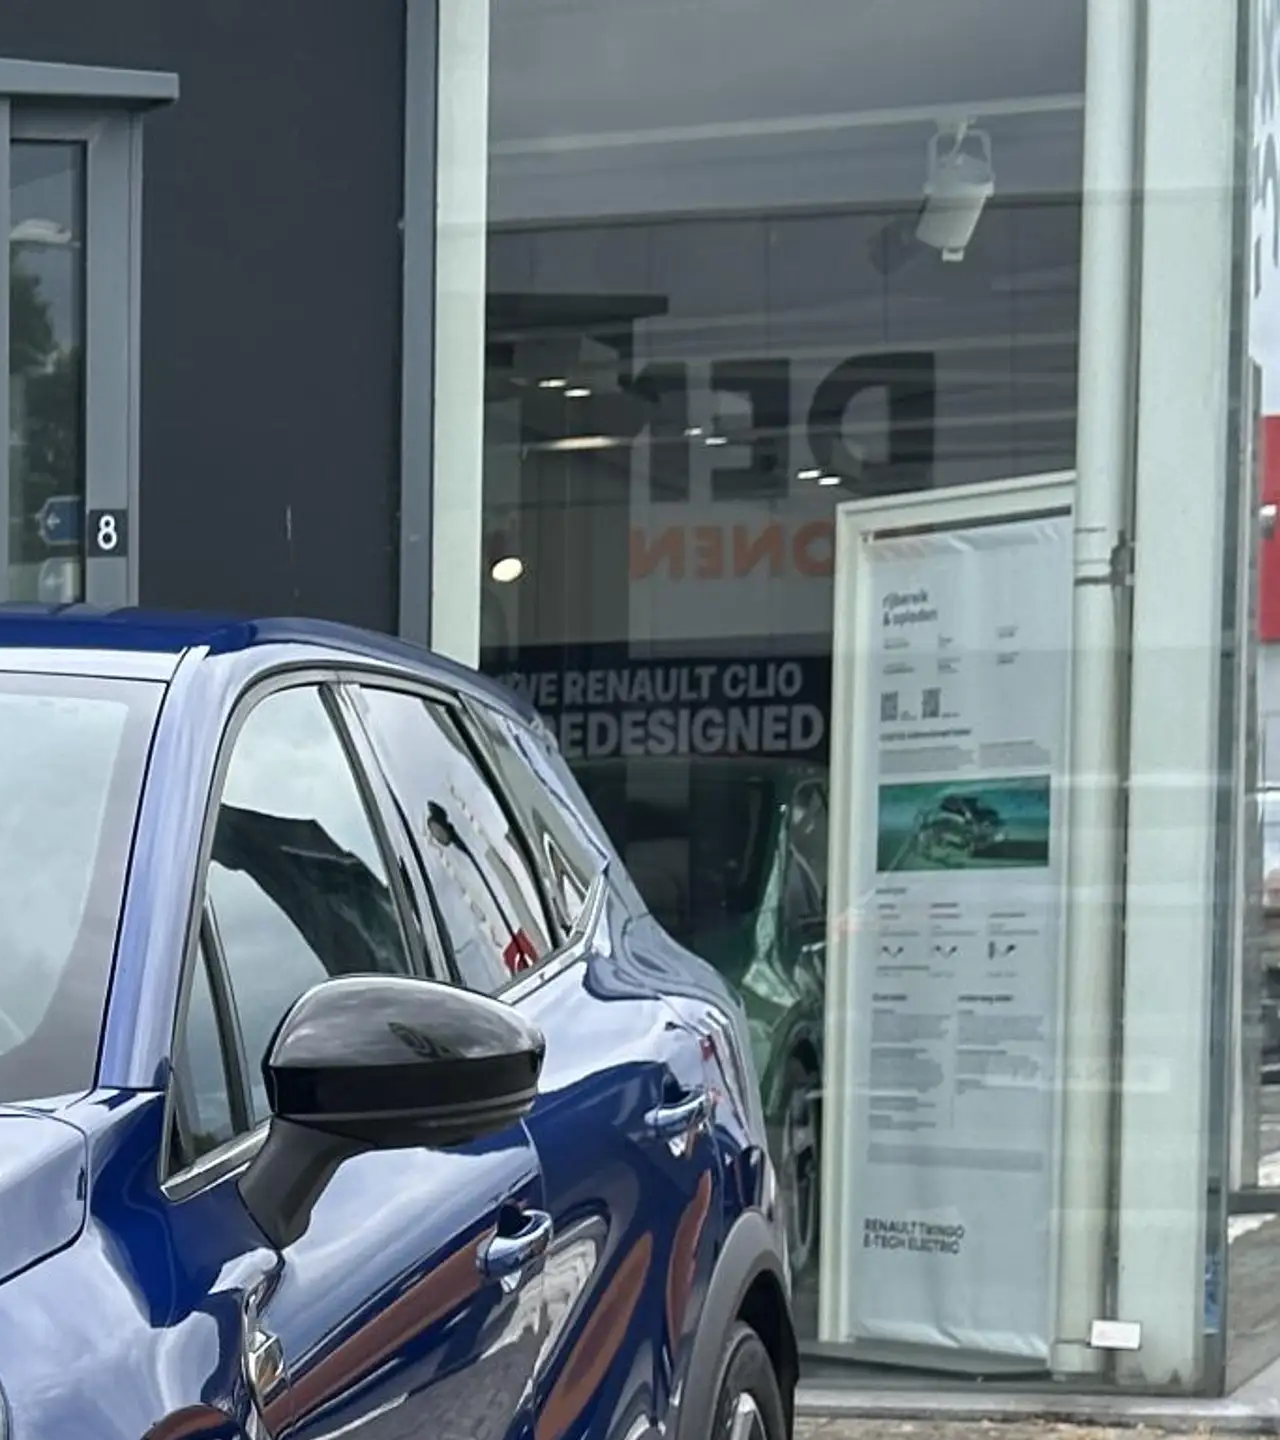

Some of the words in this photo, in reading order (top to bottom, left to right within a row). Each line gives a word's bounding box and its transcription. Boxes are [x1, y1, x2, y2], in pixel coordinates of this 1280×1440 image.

[97, 514, 118, 551] 8
[563, 664, 717, 705] RENAULT
[721, 662, 803, 699] CLIO
